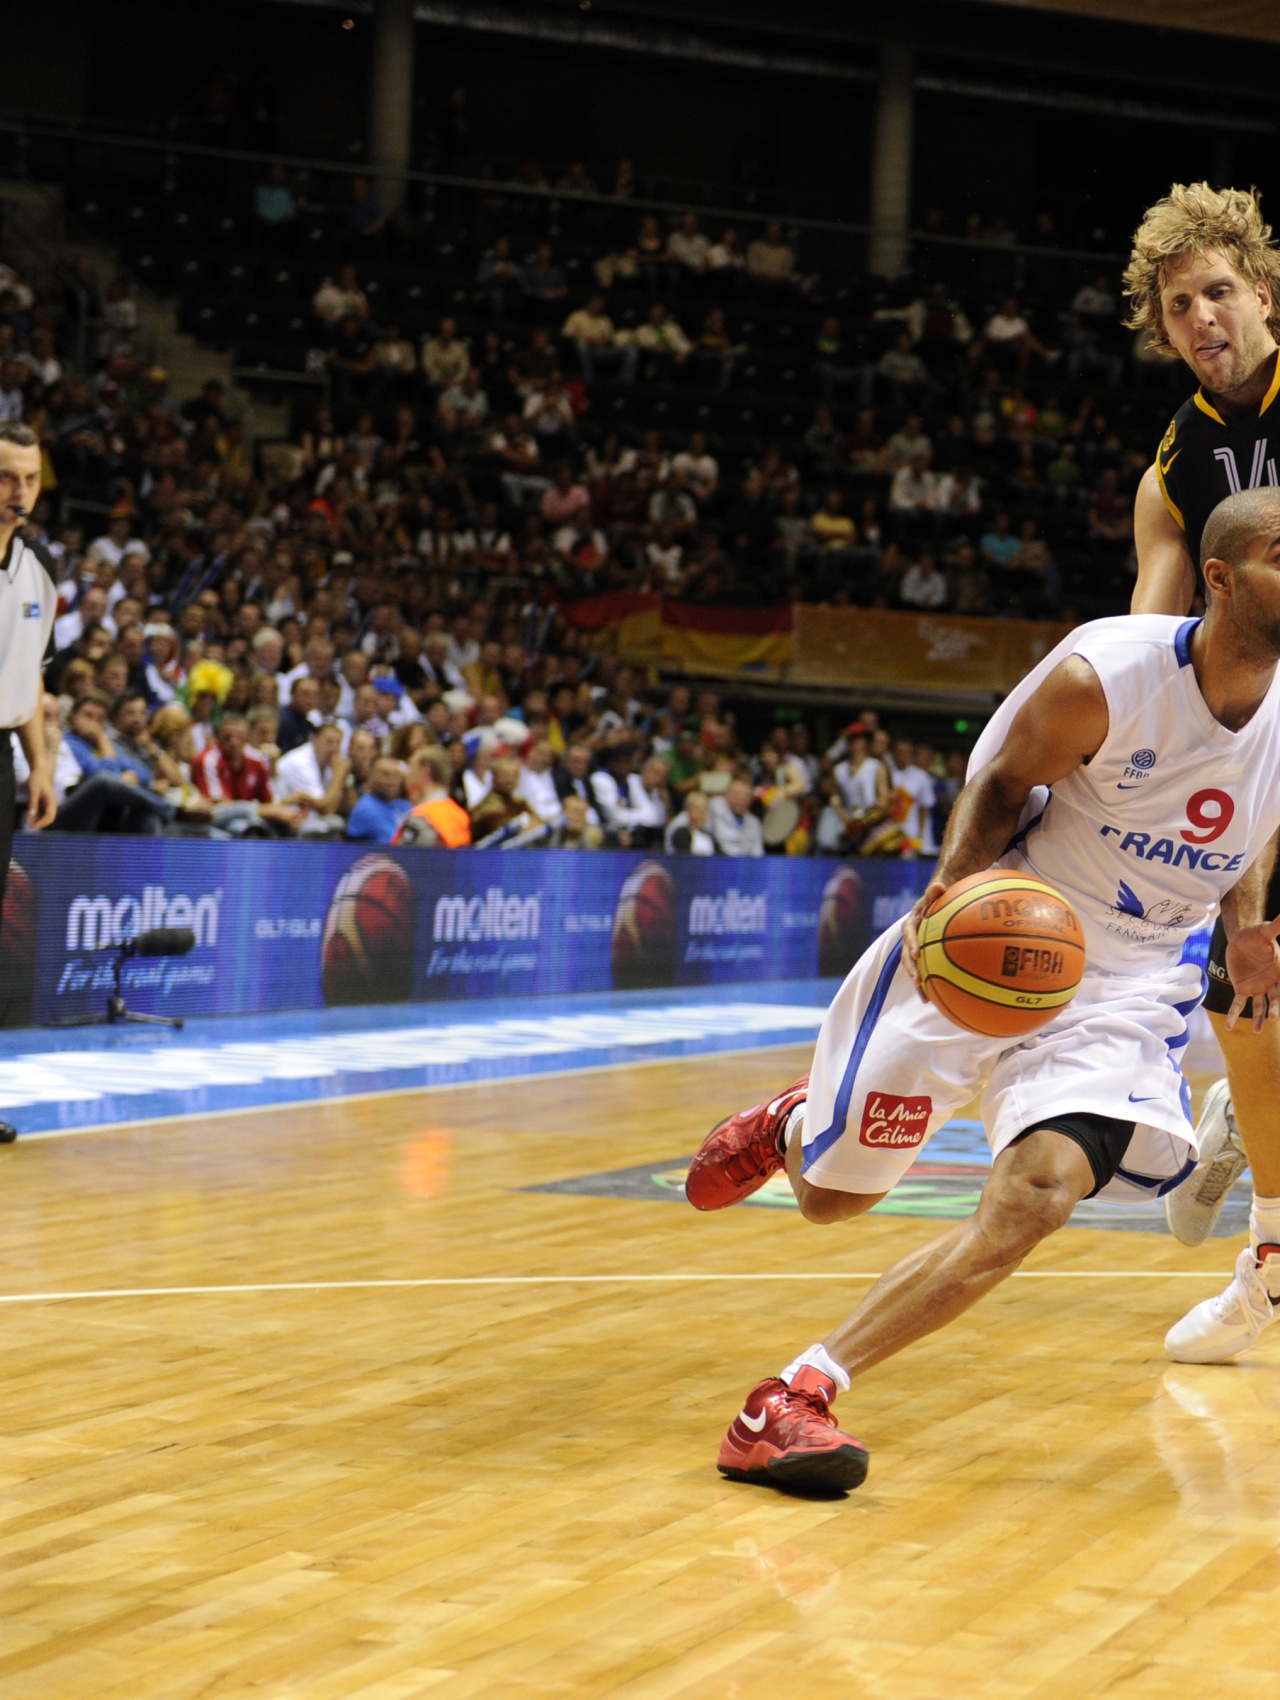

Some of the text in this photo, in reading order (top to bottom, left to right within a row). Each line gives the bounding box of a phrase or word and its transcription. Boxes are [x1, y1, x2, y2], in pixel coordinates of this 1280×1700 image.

[1213, 438, 1279, 494] 14
[1180, 788, 1235, 844] 9
[66, 886, 219, 951] molten
[433, 888, 541, 942] molten
[1020, 948, 1064, 974] FIBA
[1016, 996, 1043, 1005] GL7
[887, 1103, 928, 1121] Mie
[865, 1120, 922, 1145] Câline
